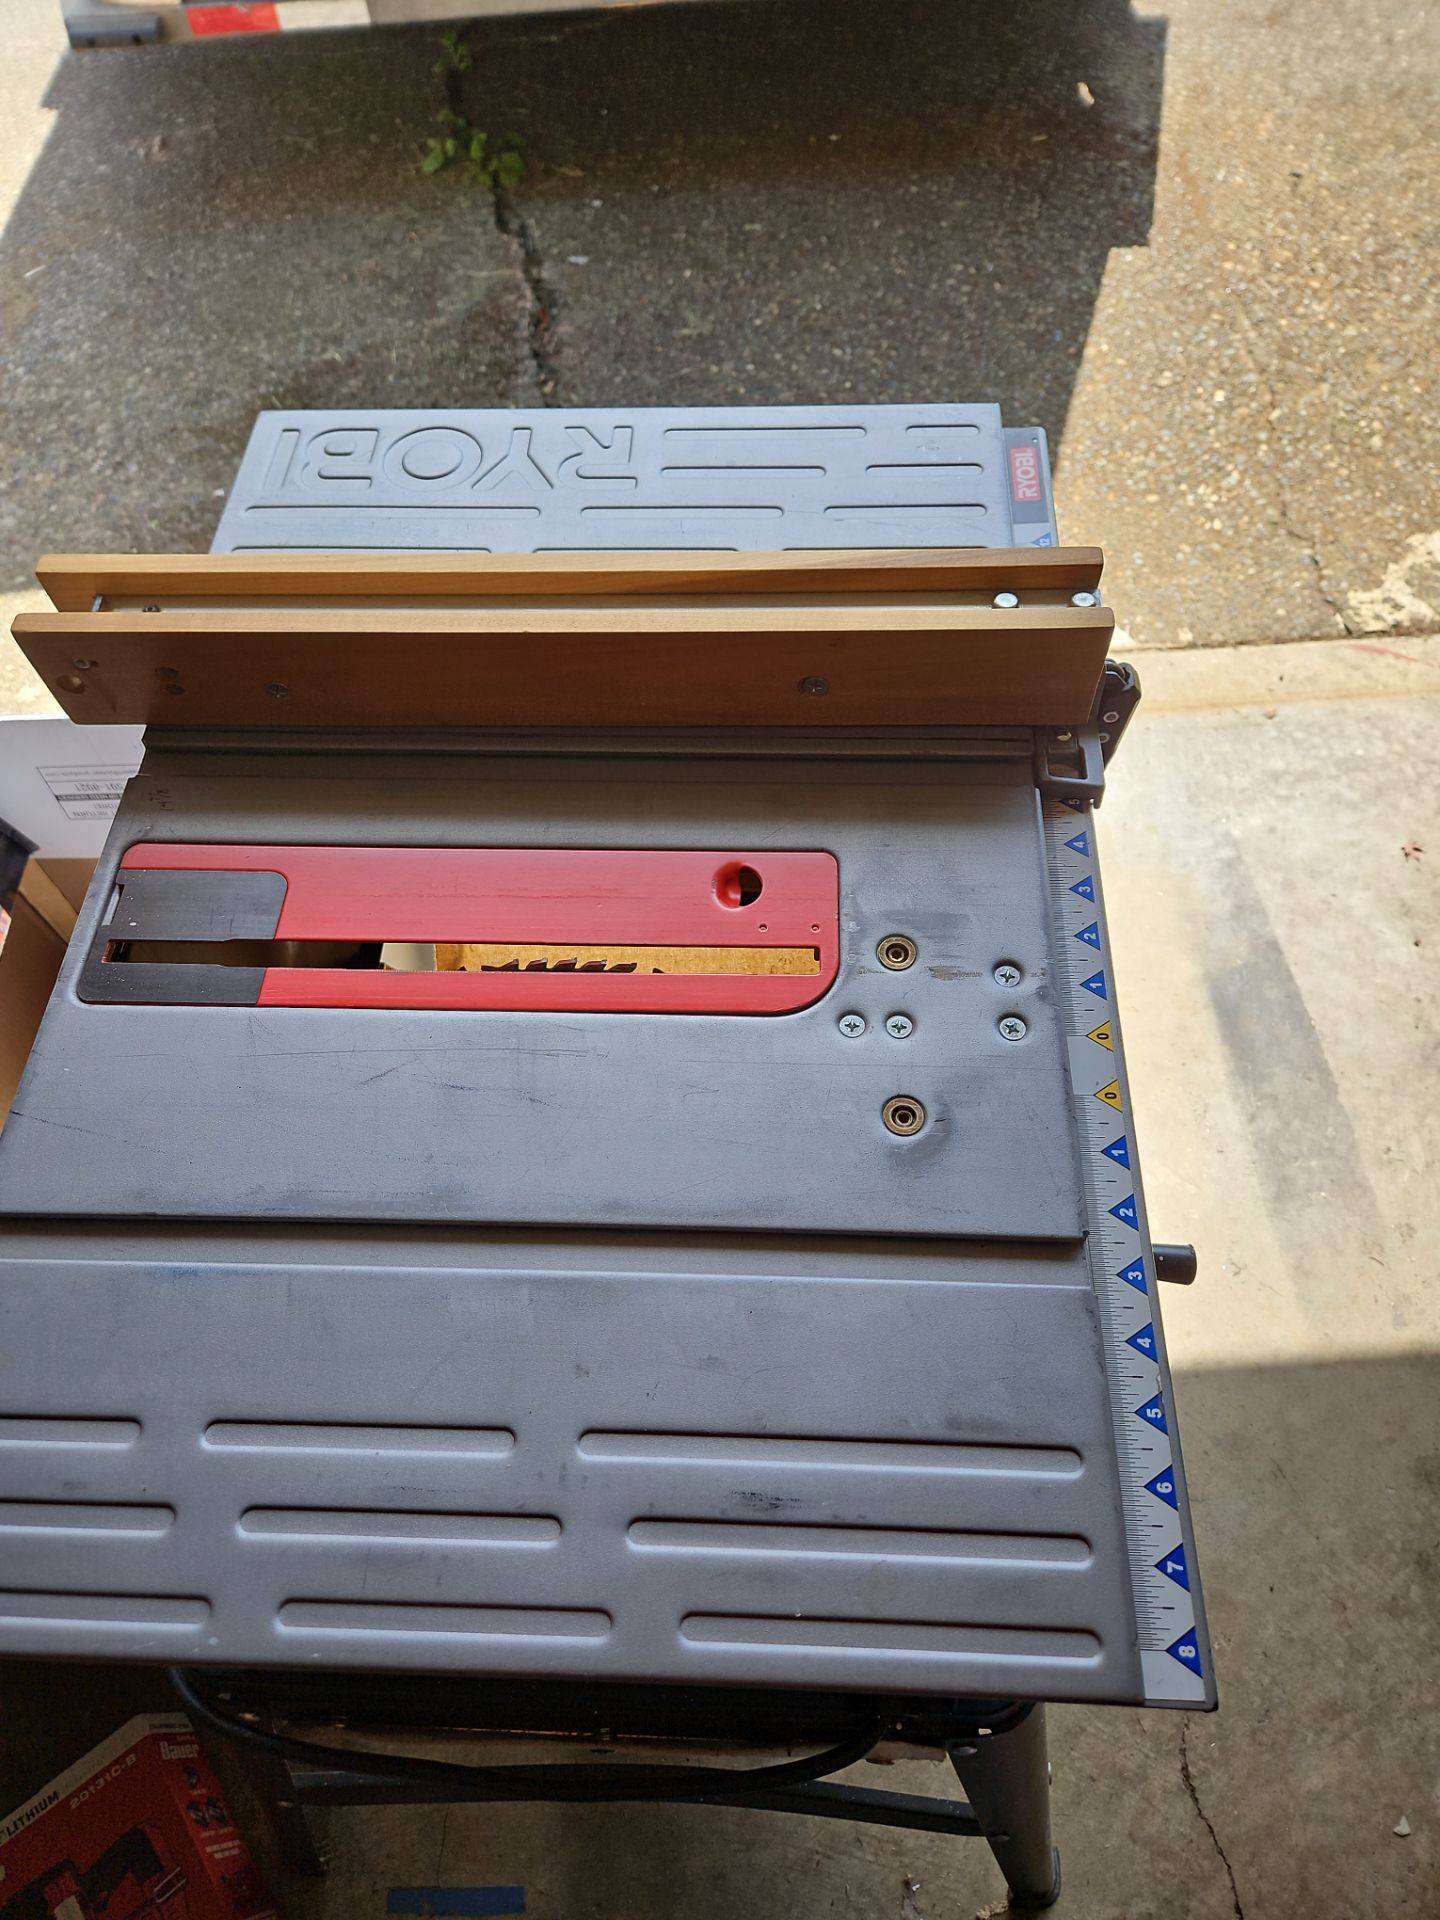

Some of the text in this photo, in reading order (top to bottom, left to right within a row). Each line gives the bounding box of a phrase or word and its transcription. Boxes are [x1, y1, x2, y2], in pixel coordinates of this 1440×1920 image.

[264, 426, 637, 491] RYOBI
[1015, 452, 1038, 499] RYOBI
[1084, 932, 1097, 940] 2
[1090, 981, 1102, 989] 1
[1104, 1092, 1118, 1100] 0
[1111, 1148, 1126, 1157] 1
[1119, 1208, 1134, 1217] 2
[1128, 1271, 1143, 1280] 3
[1136, 1337, 1152, 1348] 4
[1147, 1408, 1162, 1418] 5
[1156, 1481, 1173, 1493] 6
[1167, 1560, 1184, 1573] 7
[1178, 1645, 1196, 1658] 8
[160, 1741, 200, 1760] Bauer
[6, 1791, 60, 1837] LITHIUM
